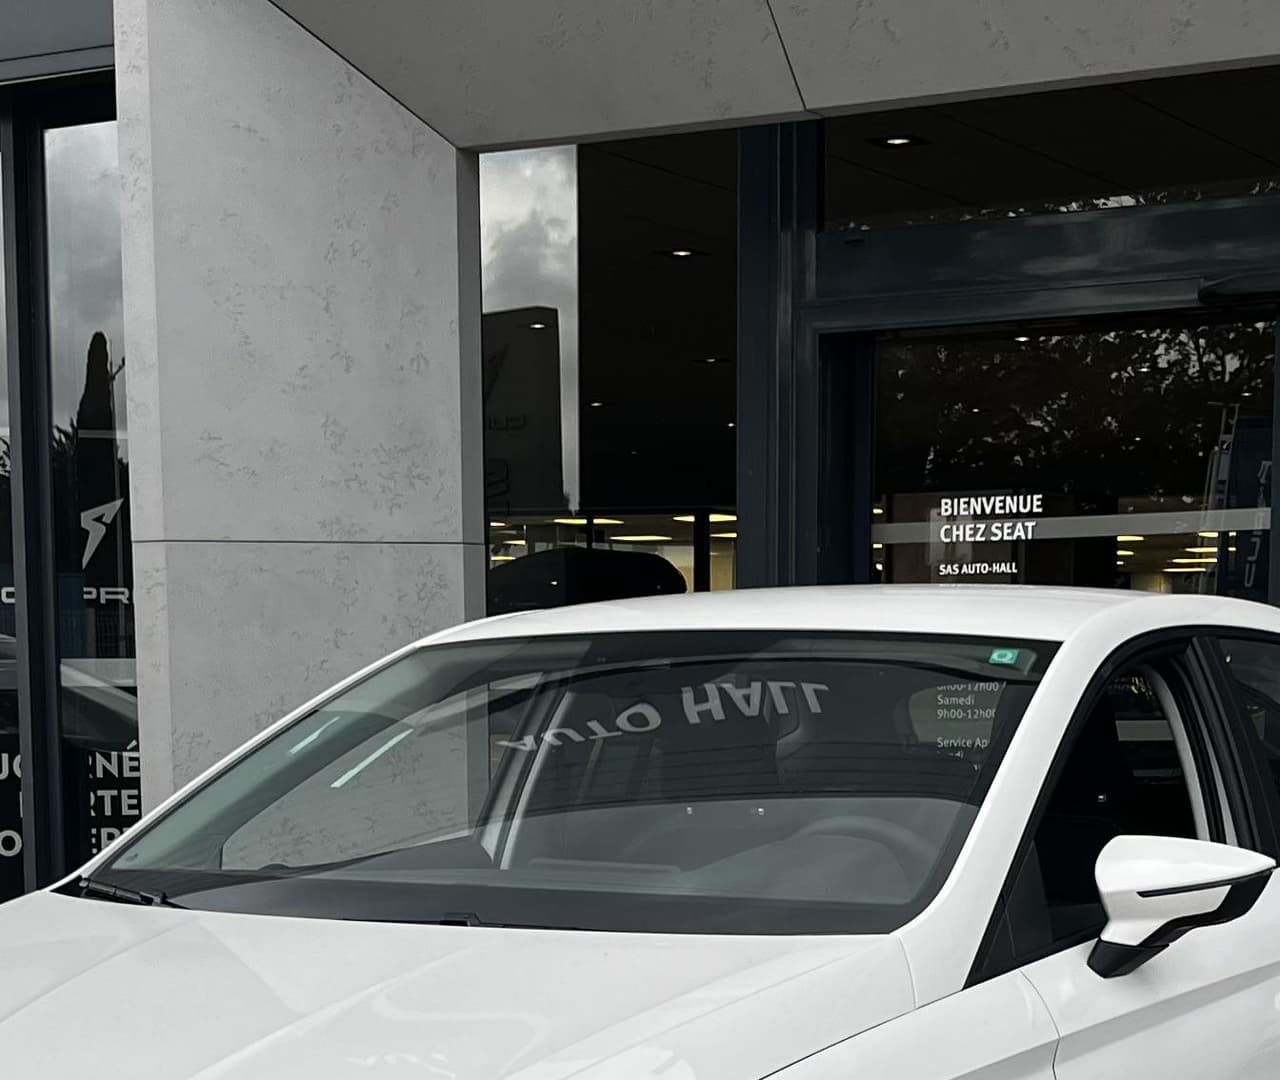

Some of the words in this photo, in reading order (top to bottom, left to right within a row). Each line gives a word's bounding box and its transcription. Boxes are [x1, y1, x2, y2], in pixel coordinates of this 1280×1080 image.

[940, 494, 1044, 516] BIENVENUE
[940, 523, 986, 543] CHEZ
[990, 521, 1036, 541] SEAT
[939, 563, 959, 575] SAS
[961, 562, 1018, 575] AUTO-HALL
[936, 694, 975, 706] Samedi
[936, 737, 972, 748] Service
[974, 737, 989, 749] Ap
